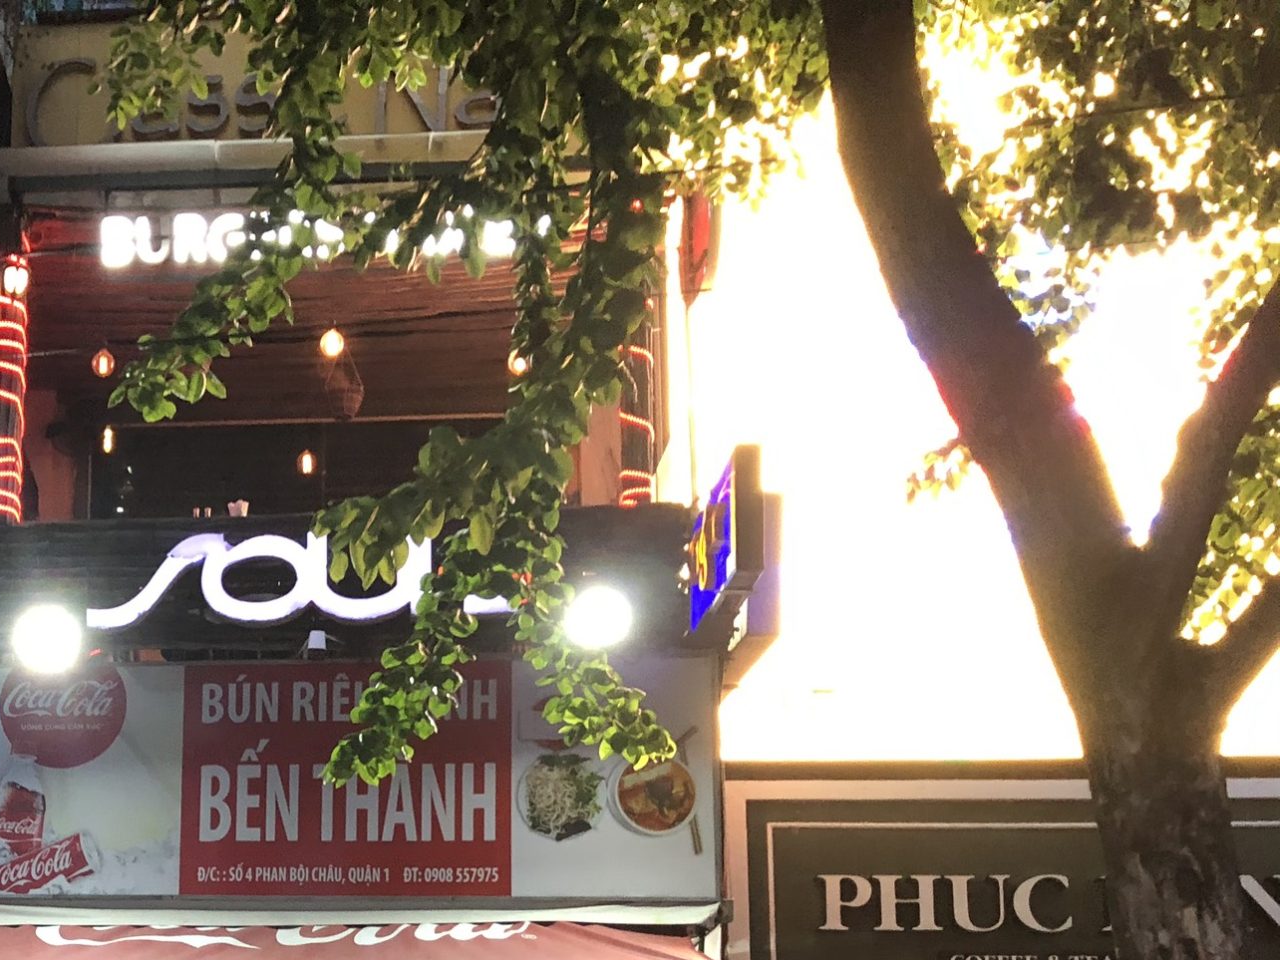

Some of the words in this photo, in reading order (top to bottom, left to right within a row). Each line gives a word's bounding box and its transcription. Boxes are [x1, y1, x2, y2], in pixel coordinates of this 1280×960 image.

[3, 680, 118, 718] Coca-Cola
[202, 674, 279, 724] BÚN
[199, 738, 300, 842] BẾN
[229, 862, 243, 882] SỐ
[245, 867, 253, 881] 4
[255, 867, 287, 882] PHAN
[290, 864, 309, 885] BỘI
[312, 863, 345, 885] CHÂU,
[348, 864, 381, 885] QUẬN
[384, 867, 390, 881] 1
[403, 867, 422, 882] ĐT:
[424, 867, 453, 882] 0908
[456, 867, 499, 882] 557975
